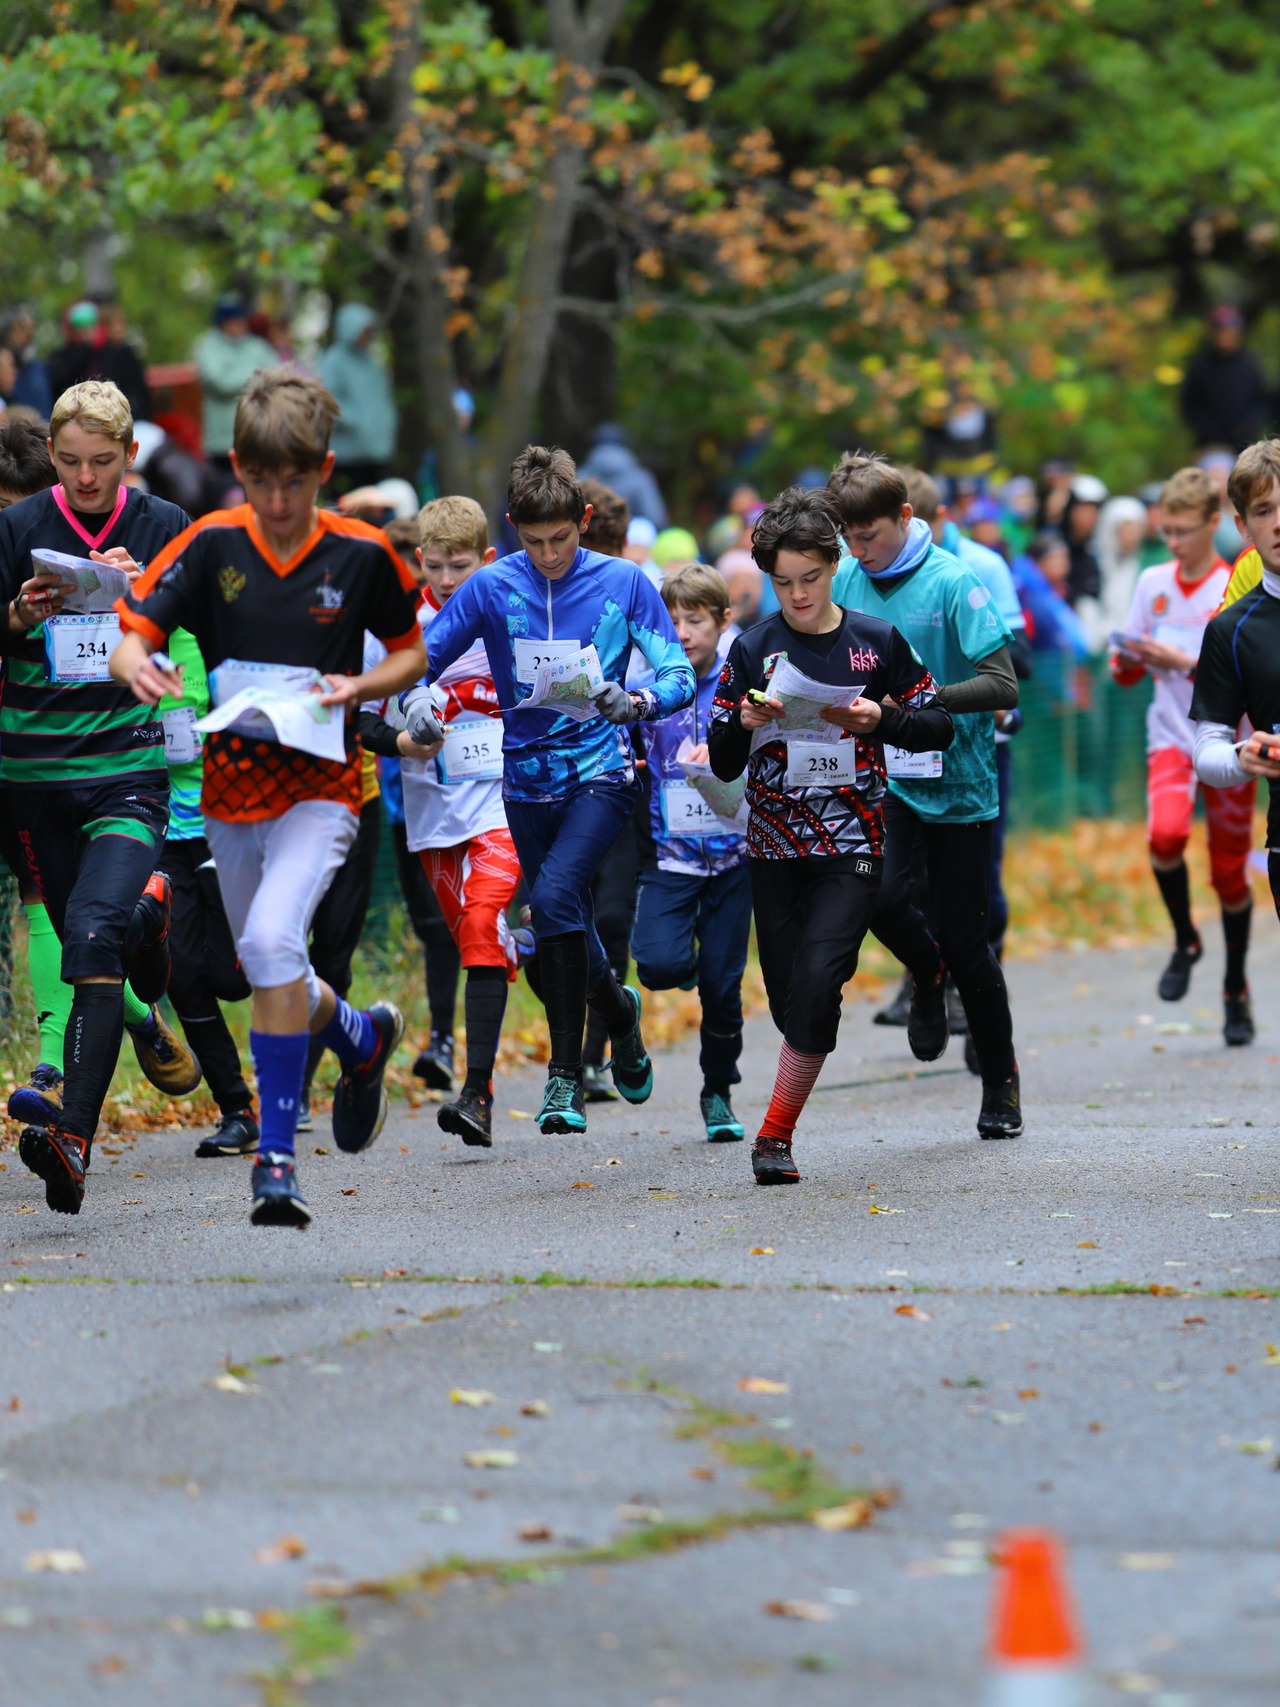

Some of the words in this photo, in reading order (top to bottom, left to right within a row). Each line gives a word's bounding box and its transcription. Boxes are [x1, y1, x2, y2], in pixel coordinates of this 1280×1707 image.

[76, 641, 107, 658] 234
[462, 743, 490, 760] 235
[808, 757, 838, 771] 238
